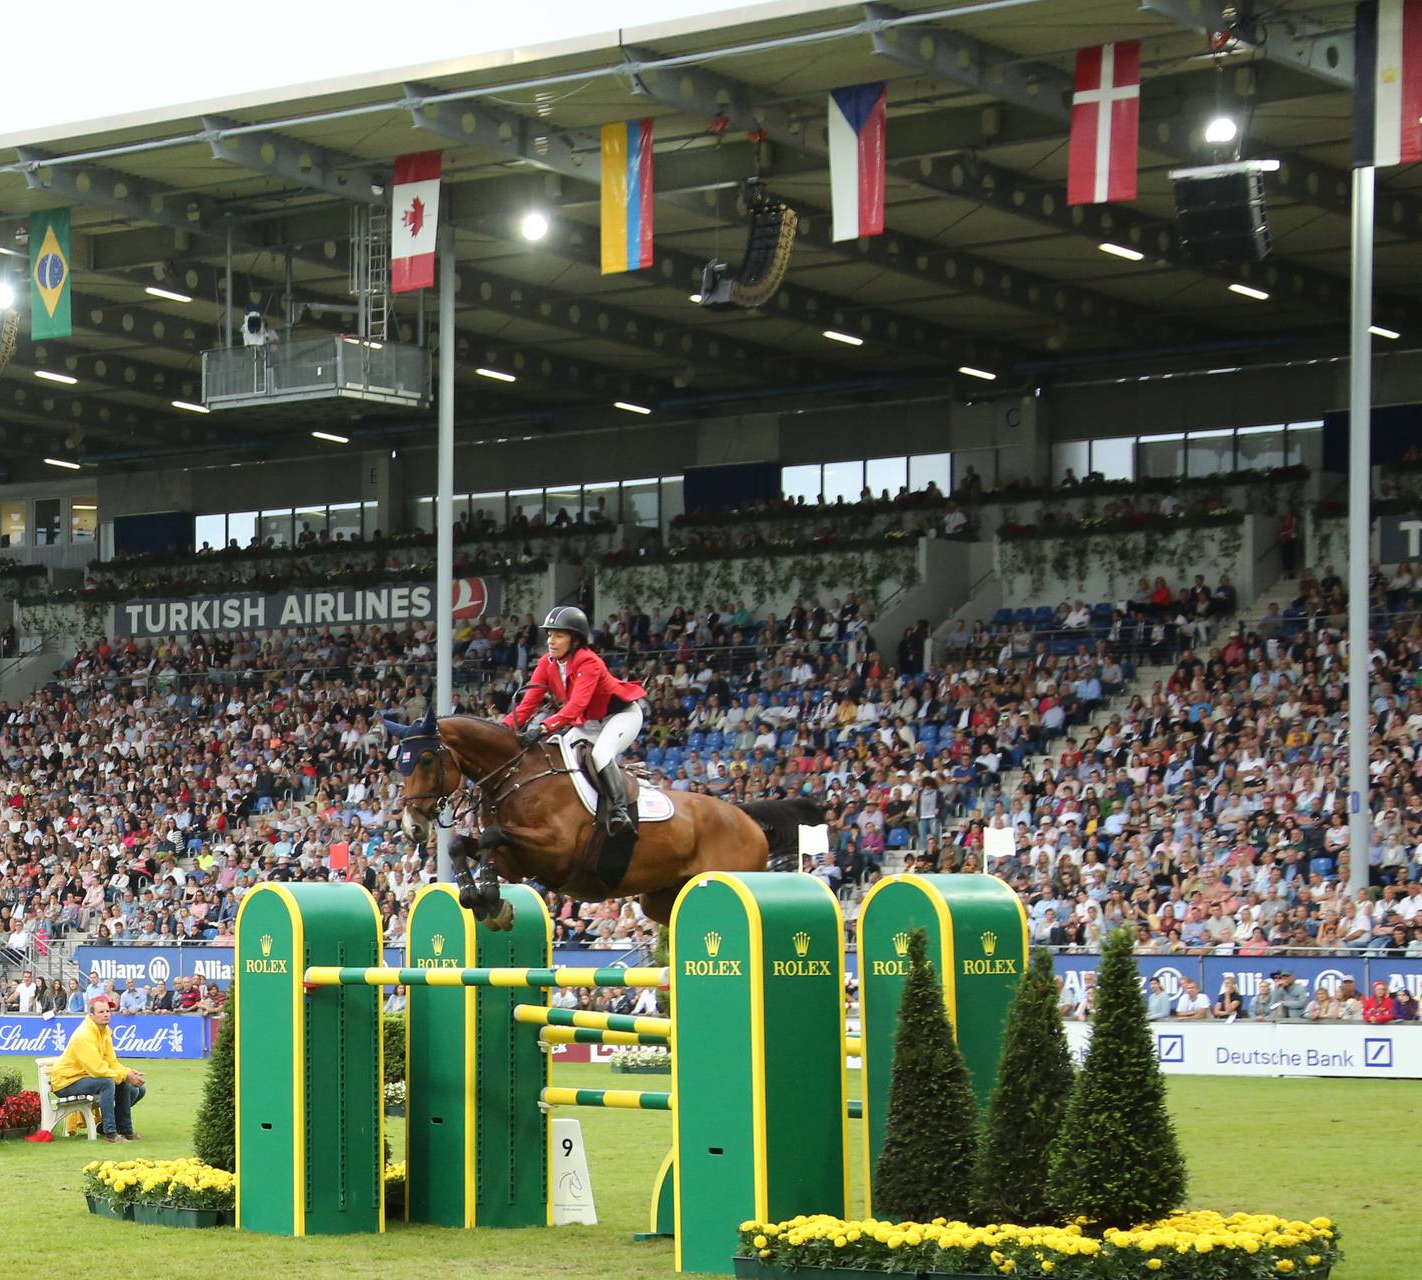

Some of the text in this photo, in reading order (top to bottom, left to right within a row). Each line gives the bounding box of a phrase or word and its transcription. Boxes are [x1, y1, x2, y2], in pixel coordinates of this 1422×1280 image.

[125, 586, 431, 634] TURKISH AIRLINES
[90, 959, 146, 979] Allianz
[193, 959, 234, 980] Allia
[245, 959, 288, 974] ROLEX
[684, 960, 742, 976] ROLEX
[773, 960, 832, 976] ROLEX
[963, 959, 1017, 975] ROLEX
[113, 1024, 169, 1052] Lindt
[1216, 1046, 1354, 1068] Deutsche Bank
[562, 1138, 573, 1157] 9
